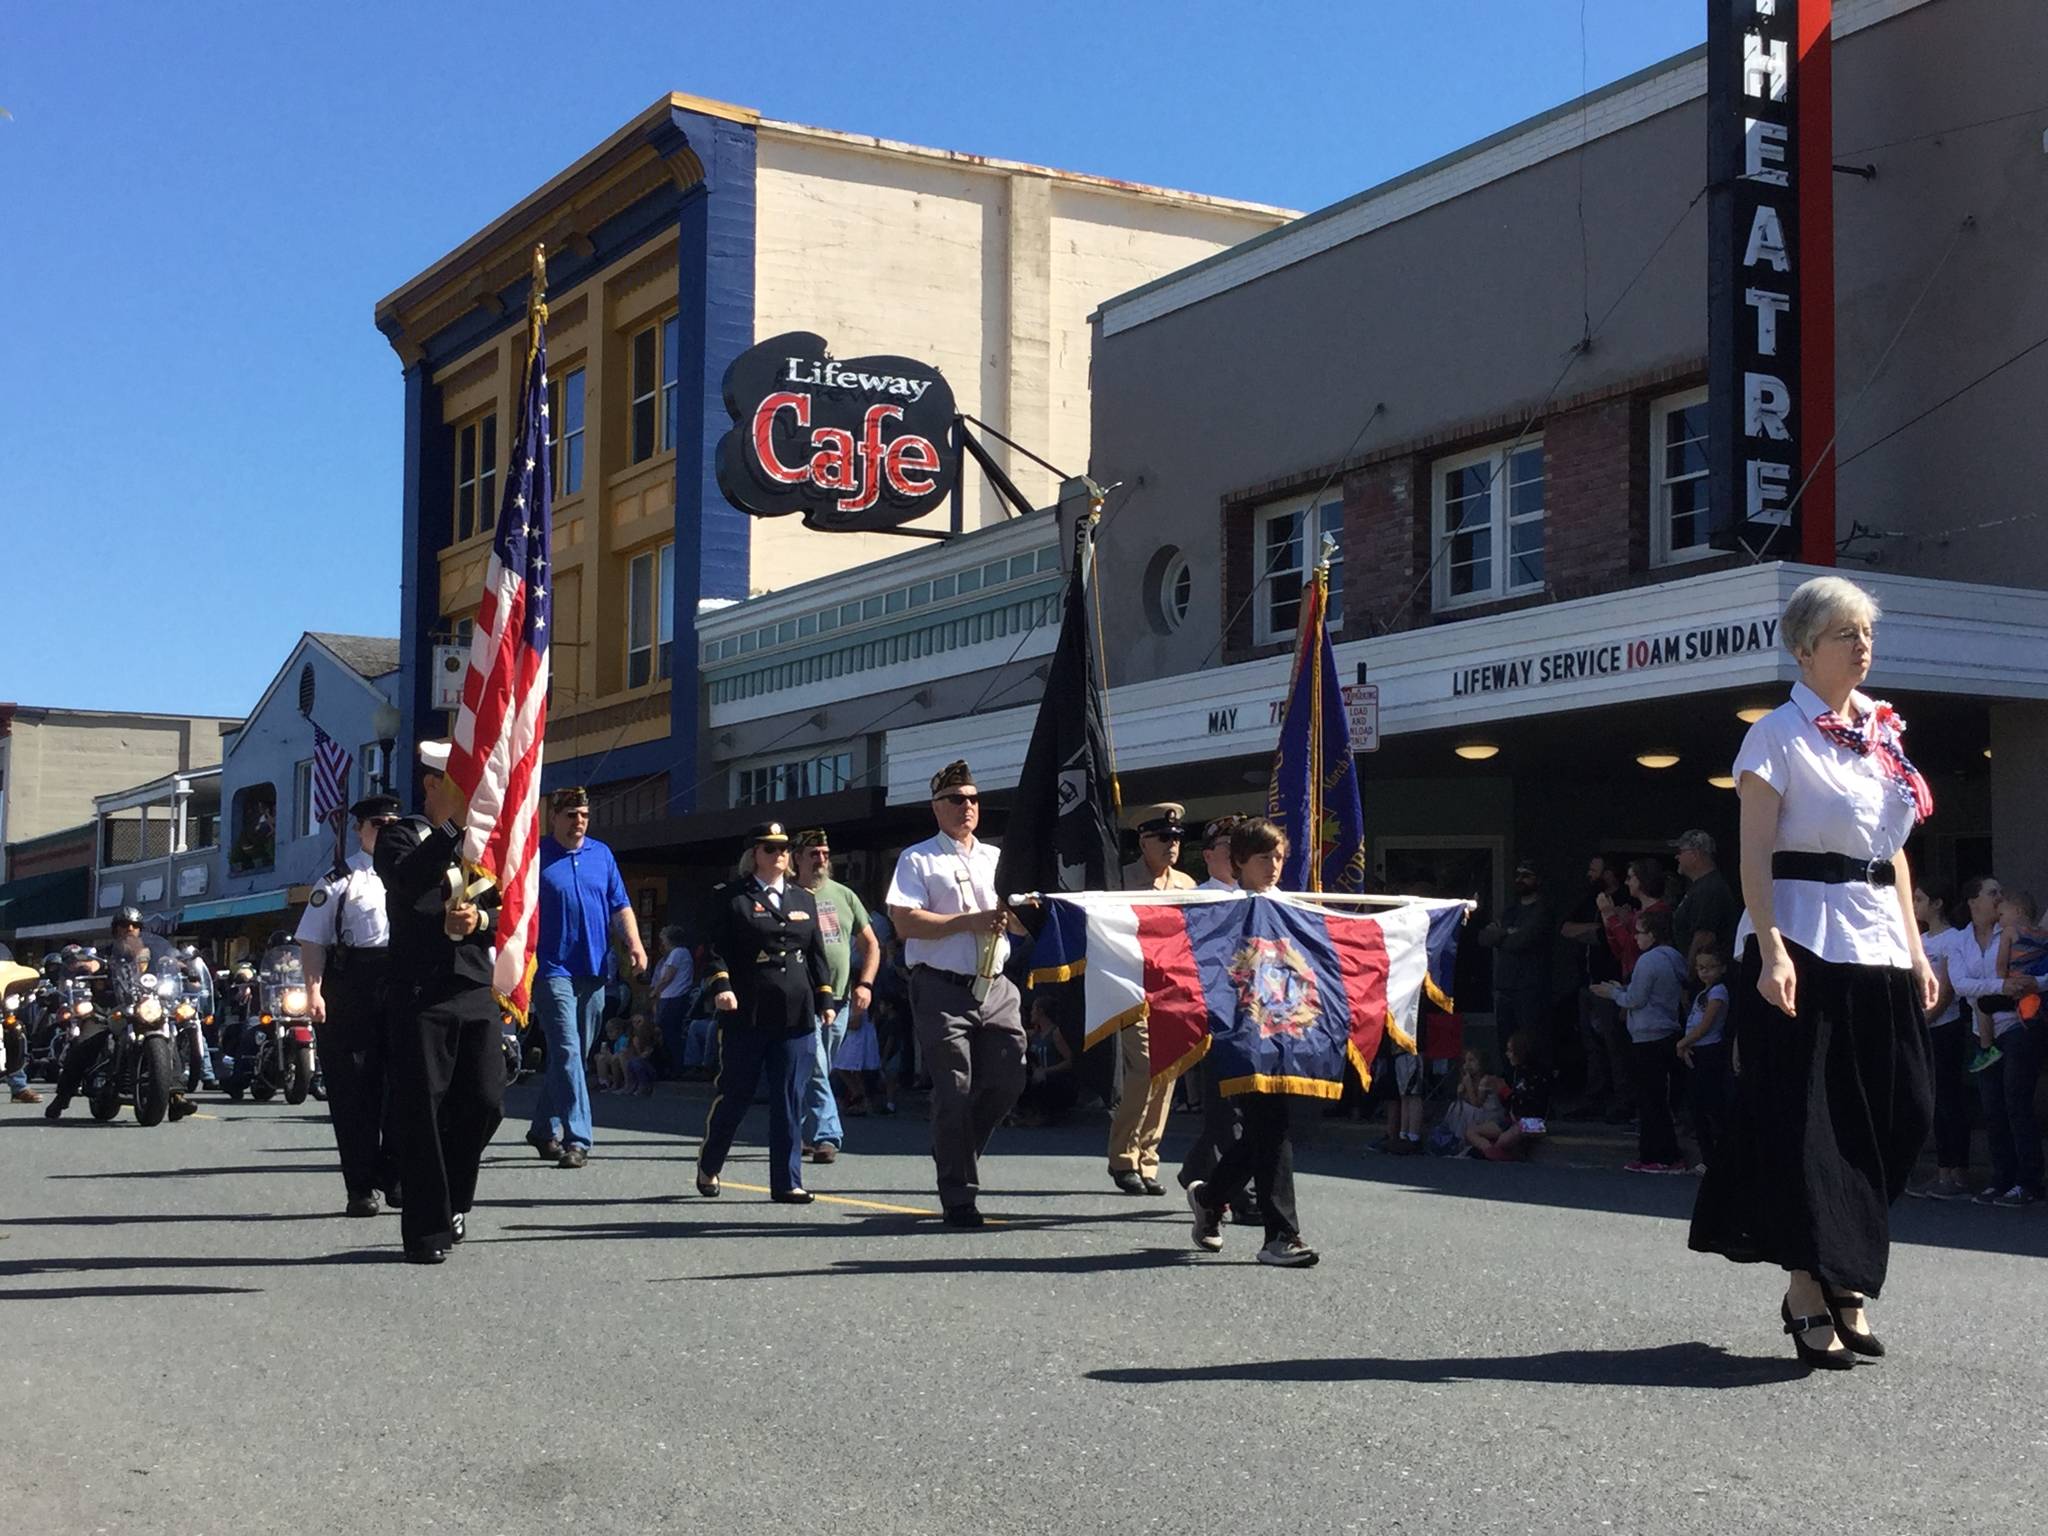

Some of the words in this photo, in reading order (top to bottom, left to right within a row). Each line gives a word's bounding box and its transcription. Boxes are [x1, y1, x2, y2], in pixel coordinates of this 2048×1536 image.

[785, 357, 933, 403] Lifeway
[752, 391, 941, 511] Cafe
[1453, 660, 1532, 696] LIFEWAY
[1540, 646, 1621, 682] SERVICE
[1685, 619, 1778, 660] SUNDAY
[1208, 708, 1238, 734] MAY
[1349, 707, 1368, 716] LOAD
[1352, 717, 1367, 725] AND
[1349, 726, 1373, 735] NLOAD
